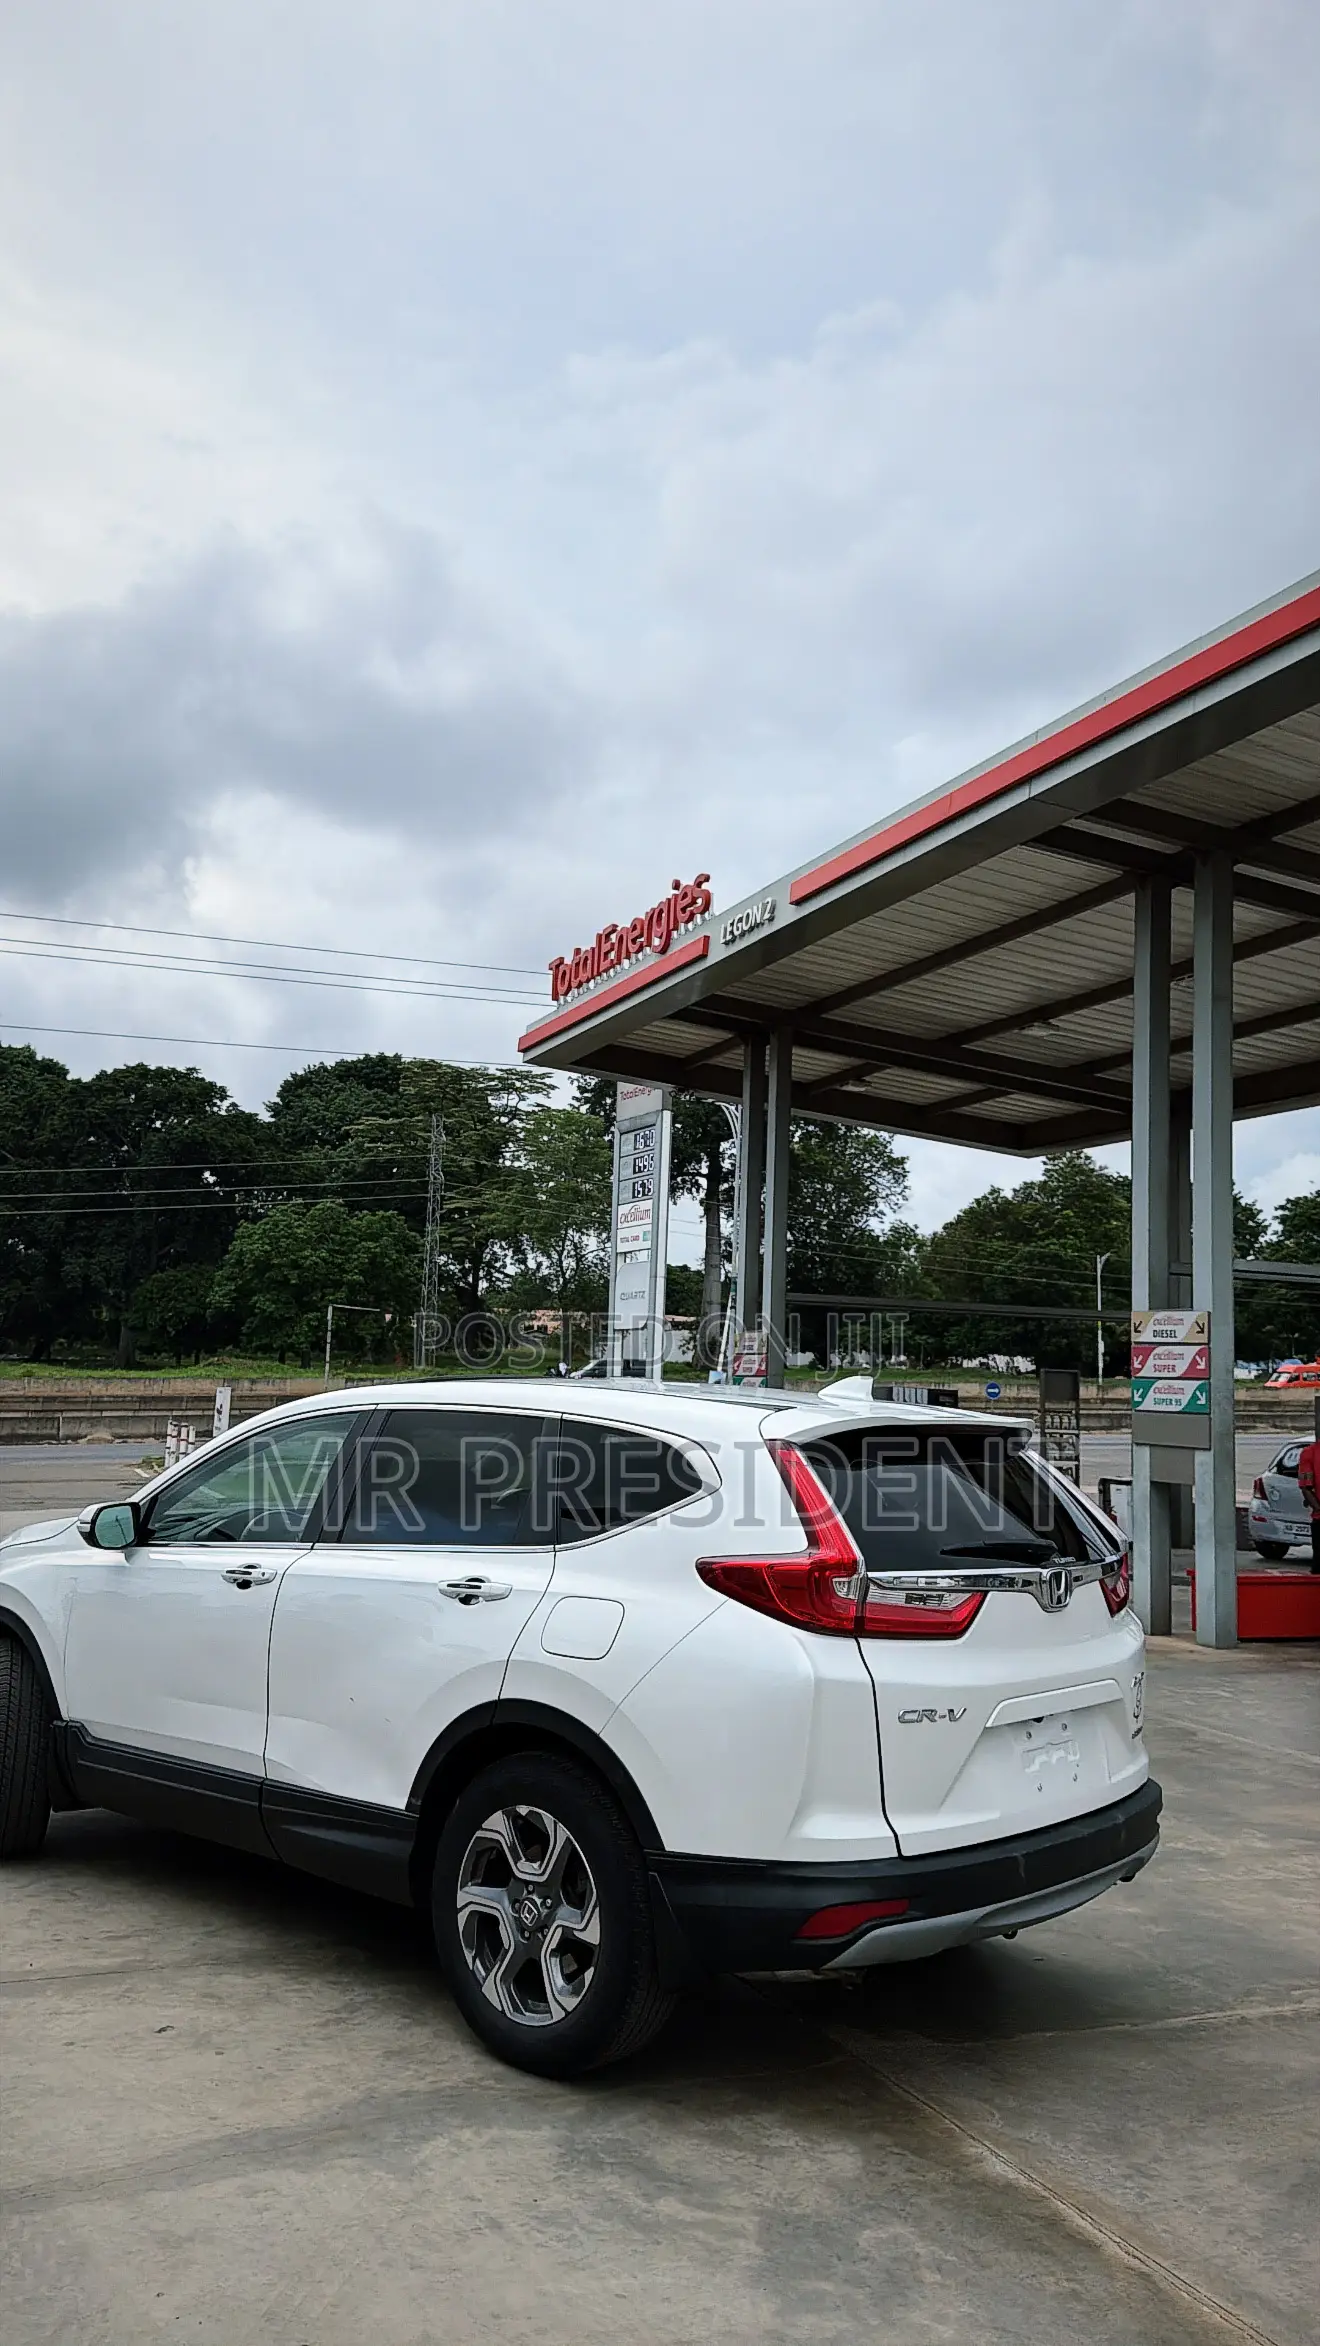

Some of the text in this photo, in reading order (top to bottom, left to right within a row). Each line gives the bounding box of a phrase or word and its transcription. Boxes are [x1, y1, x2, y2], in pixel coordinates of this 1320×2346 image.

[720, 897, 775, 944] LEGON 2
[549, 873, 711, 1000] TotalEnergies
[634, 1179, 653, 1198] 1579
[1152, 1329, 1177, 1339] DIESEL
[1153, 1363, 1176, 1373] SUPER
[1153, 1397, 1182, 1406] SUPER 95
[898, 1707, 967, 1724] CR-V
